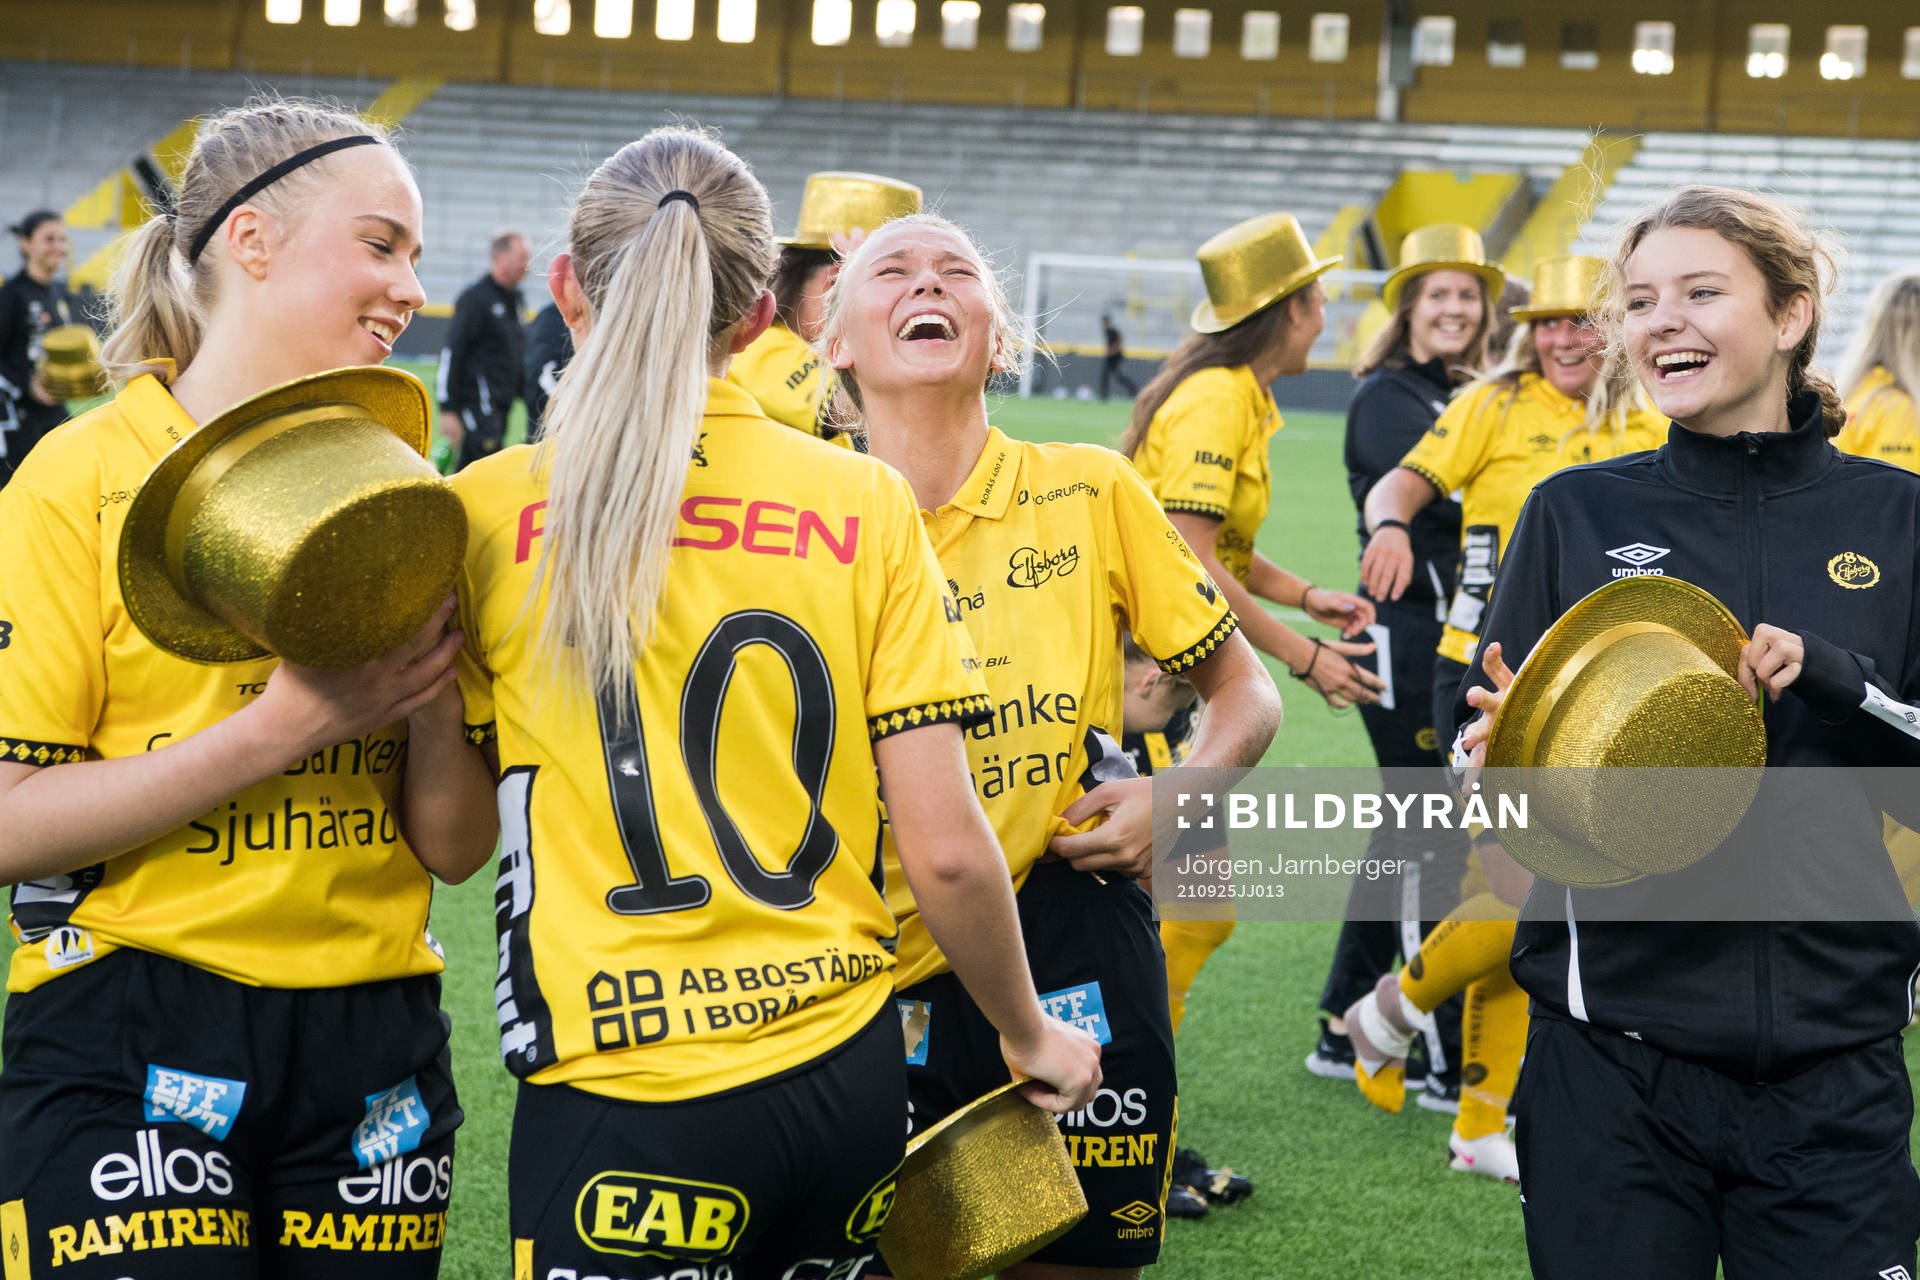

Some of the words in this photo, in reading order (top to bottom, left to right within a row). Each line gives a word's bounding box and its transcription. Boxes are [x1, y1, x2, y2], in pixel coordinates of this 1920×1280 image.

[1032, 482, 1099, 506] O-GRUPPEN
[1007, 544, 1080, 589] Elfsborg
[1612, 566, 1664, 577] umbro
[985, 656, 1011, 668] BIL
[565, 609, 839, 917] 10
[679, 967, 728, 996] AB
[734, 947, 884, 992] BOSTÄDER
[154, 1069, 228, 1112] EFF
[90, 1129, 234, 1201] ellos
[1064, 1133, 1158, 1168] IRENT
[49, 1207, 251, 1268] RAMIRENT
[278, 1209, 448, 1252] RAMIREN
[591, 1183, 737, 1251] EAB
[1117, 1225, 1154, 1239] umbro
